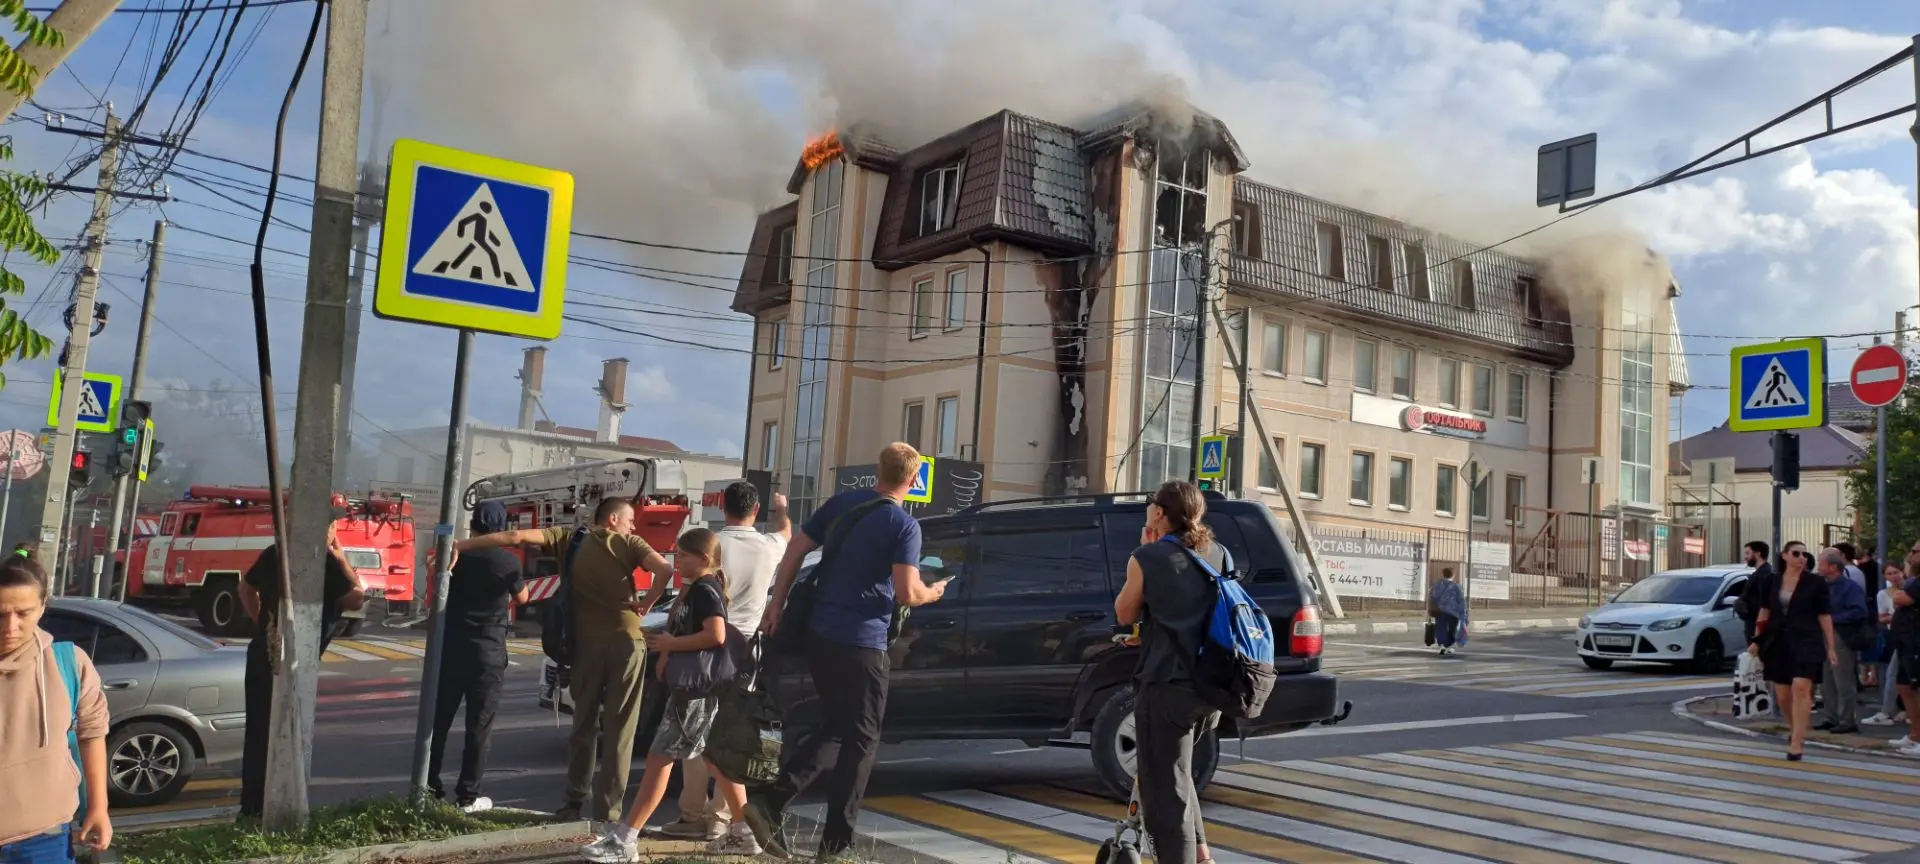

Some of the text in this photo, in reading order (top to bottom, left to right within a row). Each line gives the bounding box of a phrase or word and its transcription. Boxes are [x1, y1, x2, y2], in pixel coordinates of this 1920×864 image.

[1427, 412, 1482, 430] ОФТАЛЬМИК
[859, 475, 879, 488] СТО
[1310, 539, 1362, 554] ОСТАВЬ
[1338, 574, 1383, 587] 444-71-11
